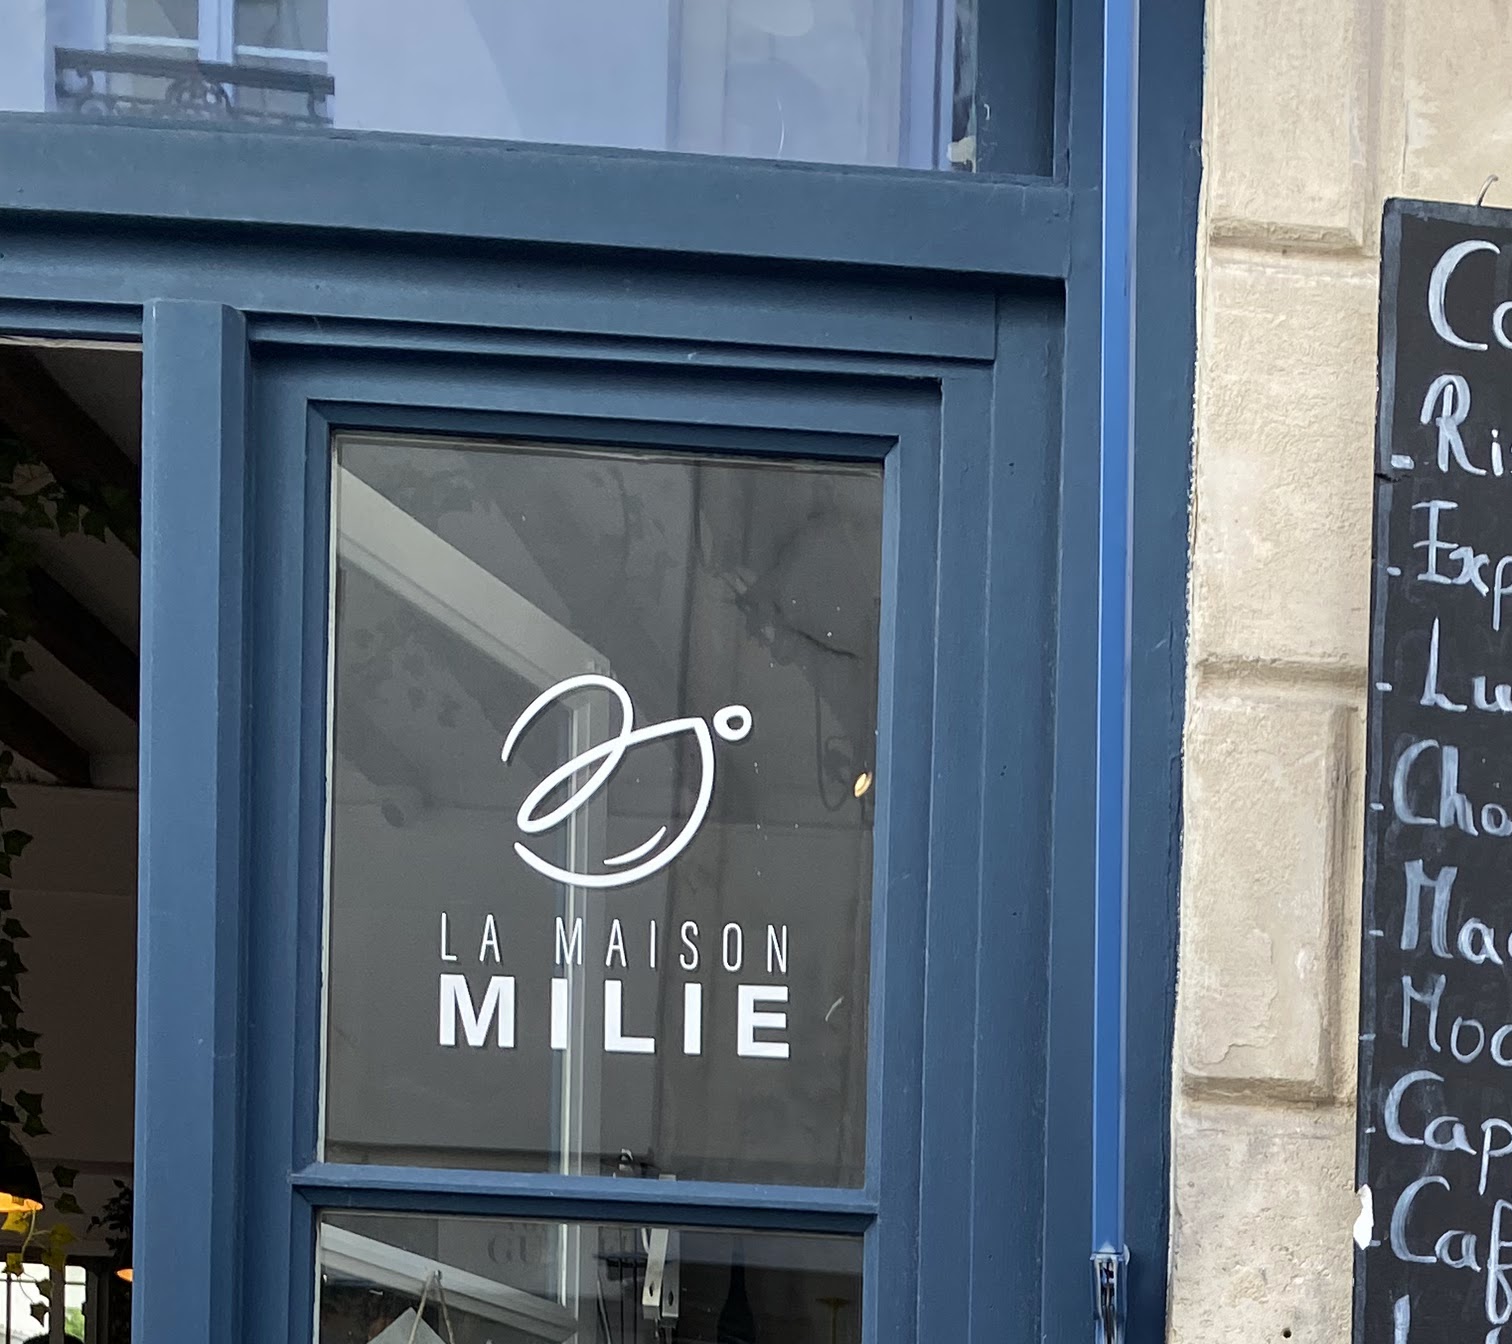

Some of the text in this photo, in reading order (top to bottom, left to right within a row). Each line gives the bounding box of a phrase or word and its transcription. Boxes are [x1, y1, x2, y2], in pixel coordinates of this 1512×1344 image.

[440, 912, 789, 975] LA MAISON
[439, 973, 790, 1059] MILIE
